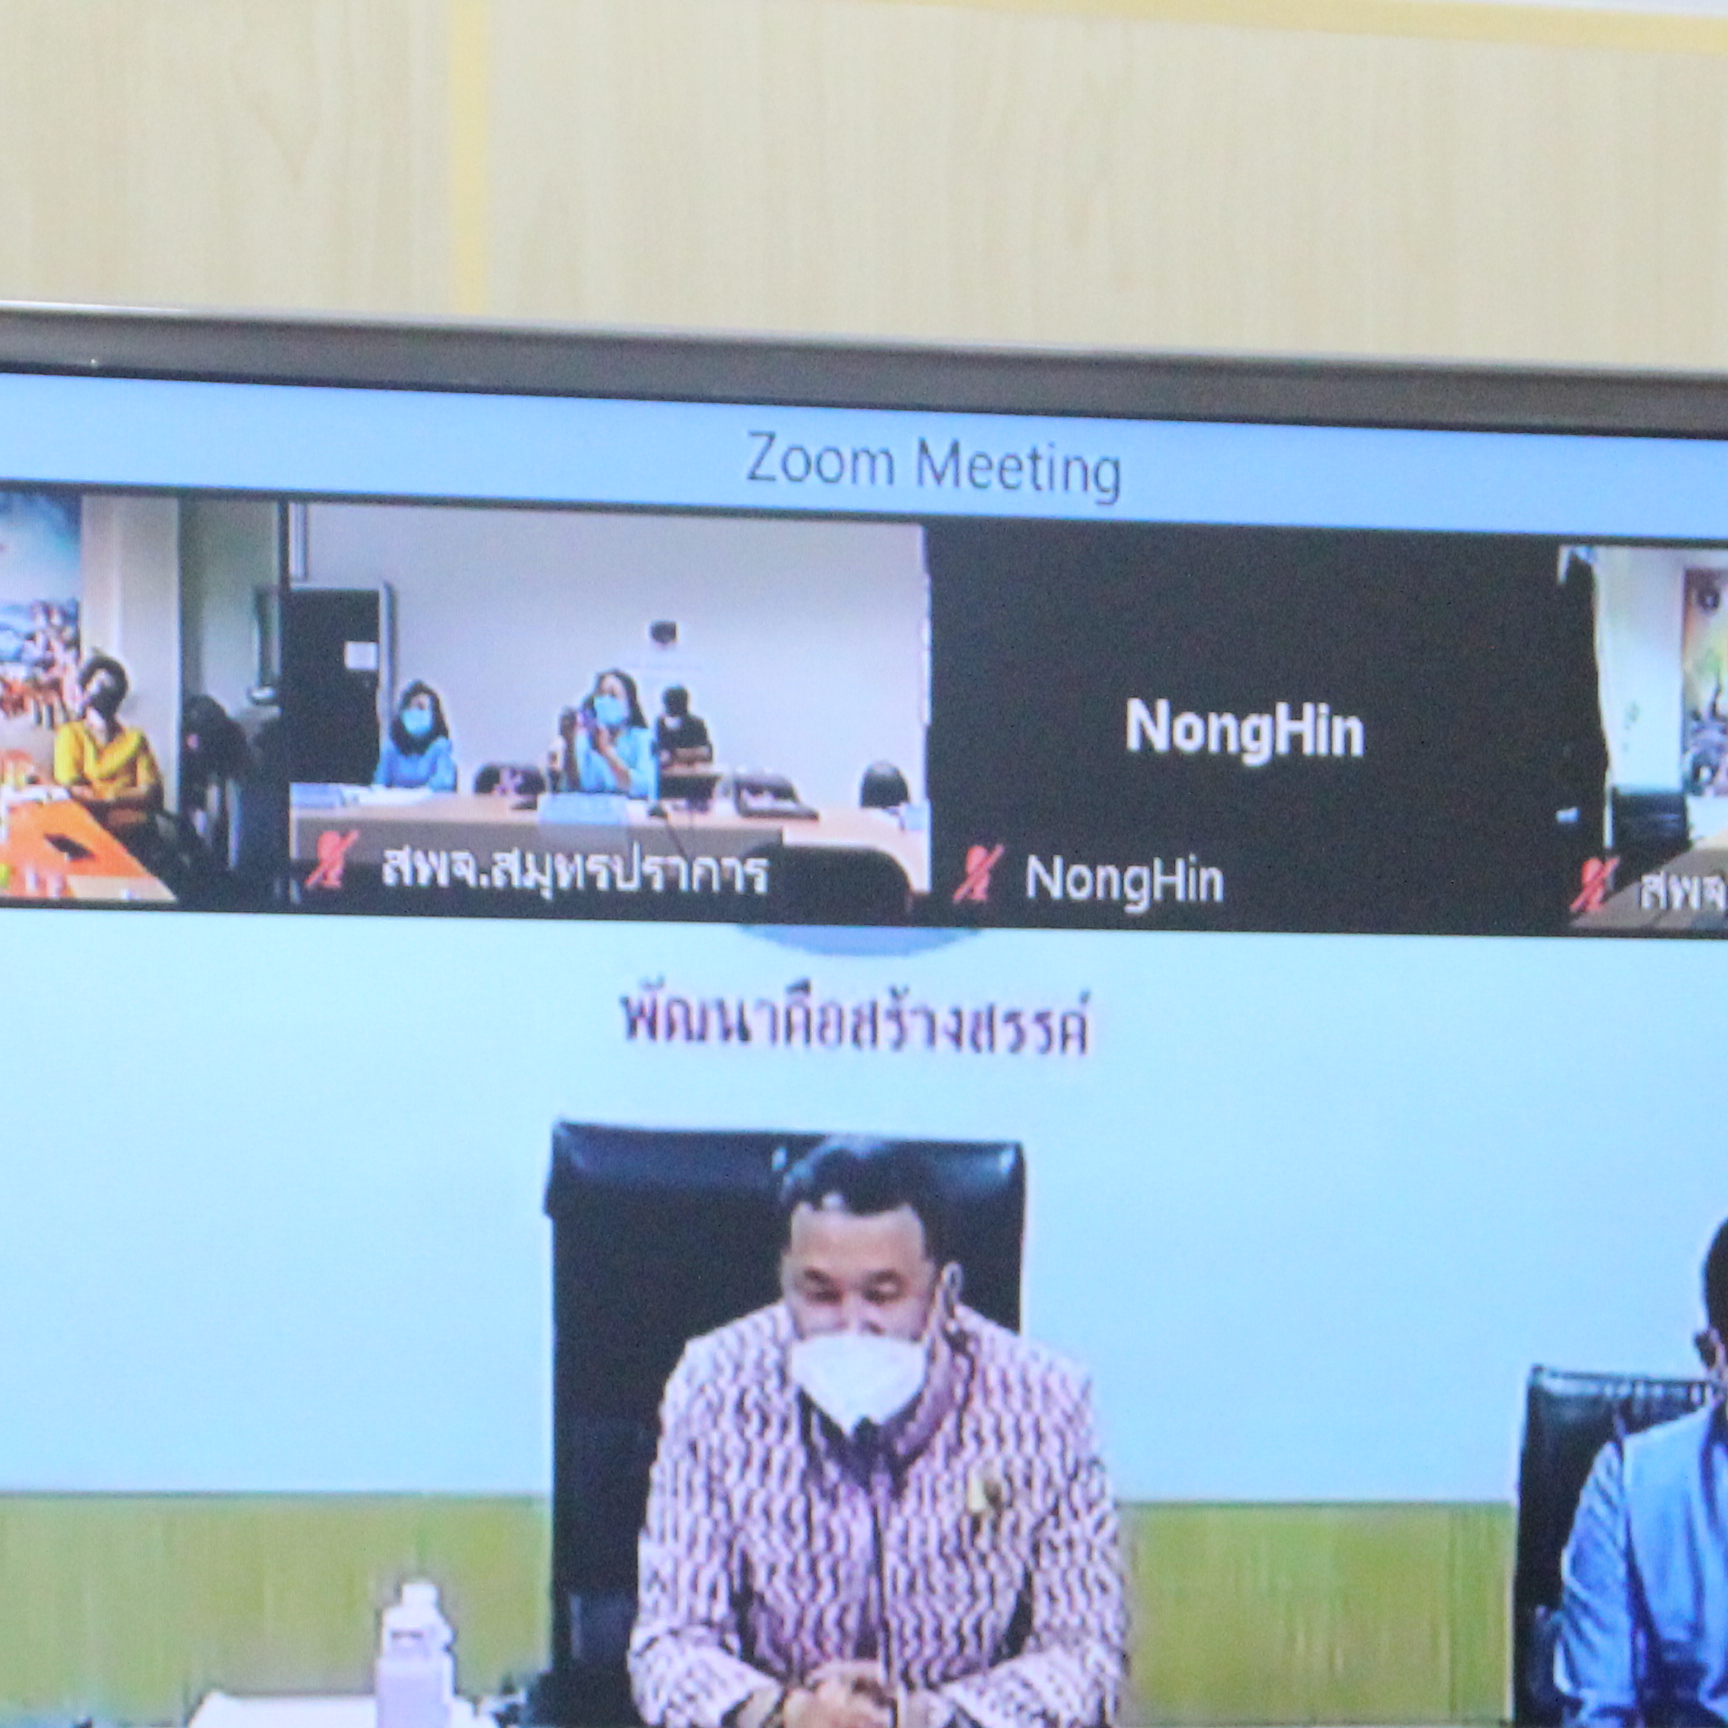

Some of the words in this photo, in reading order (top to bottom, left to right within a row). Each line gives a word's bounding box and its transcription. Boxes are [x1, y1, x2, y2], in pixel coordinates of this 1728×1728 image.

[747, 431, 895, 485] Zoom
[917, 437, 1121, 506] Meeting
[1125, 697, 1365, 767] NongHin
[381, 841, 771, 902] สพจ.สมุทรปราการ
[1026, 852, 1225, 914] NongHin
[619, 974, 1092, 1057] พัฒนาคือสร้างสรรค์
